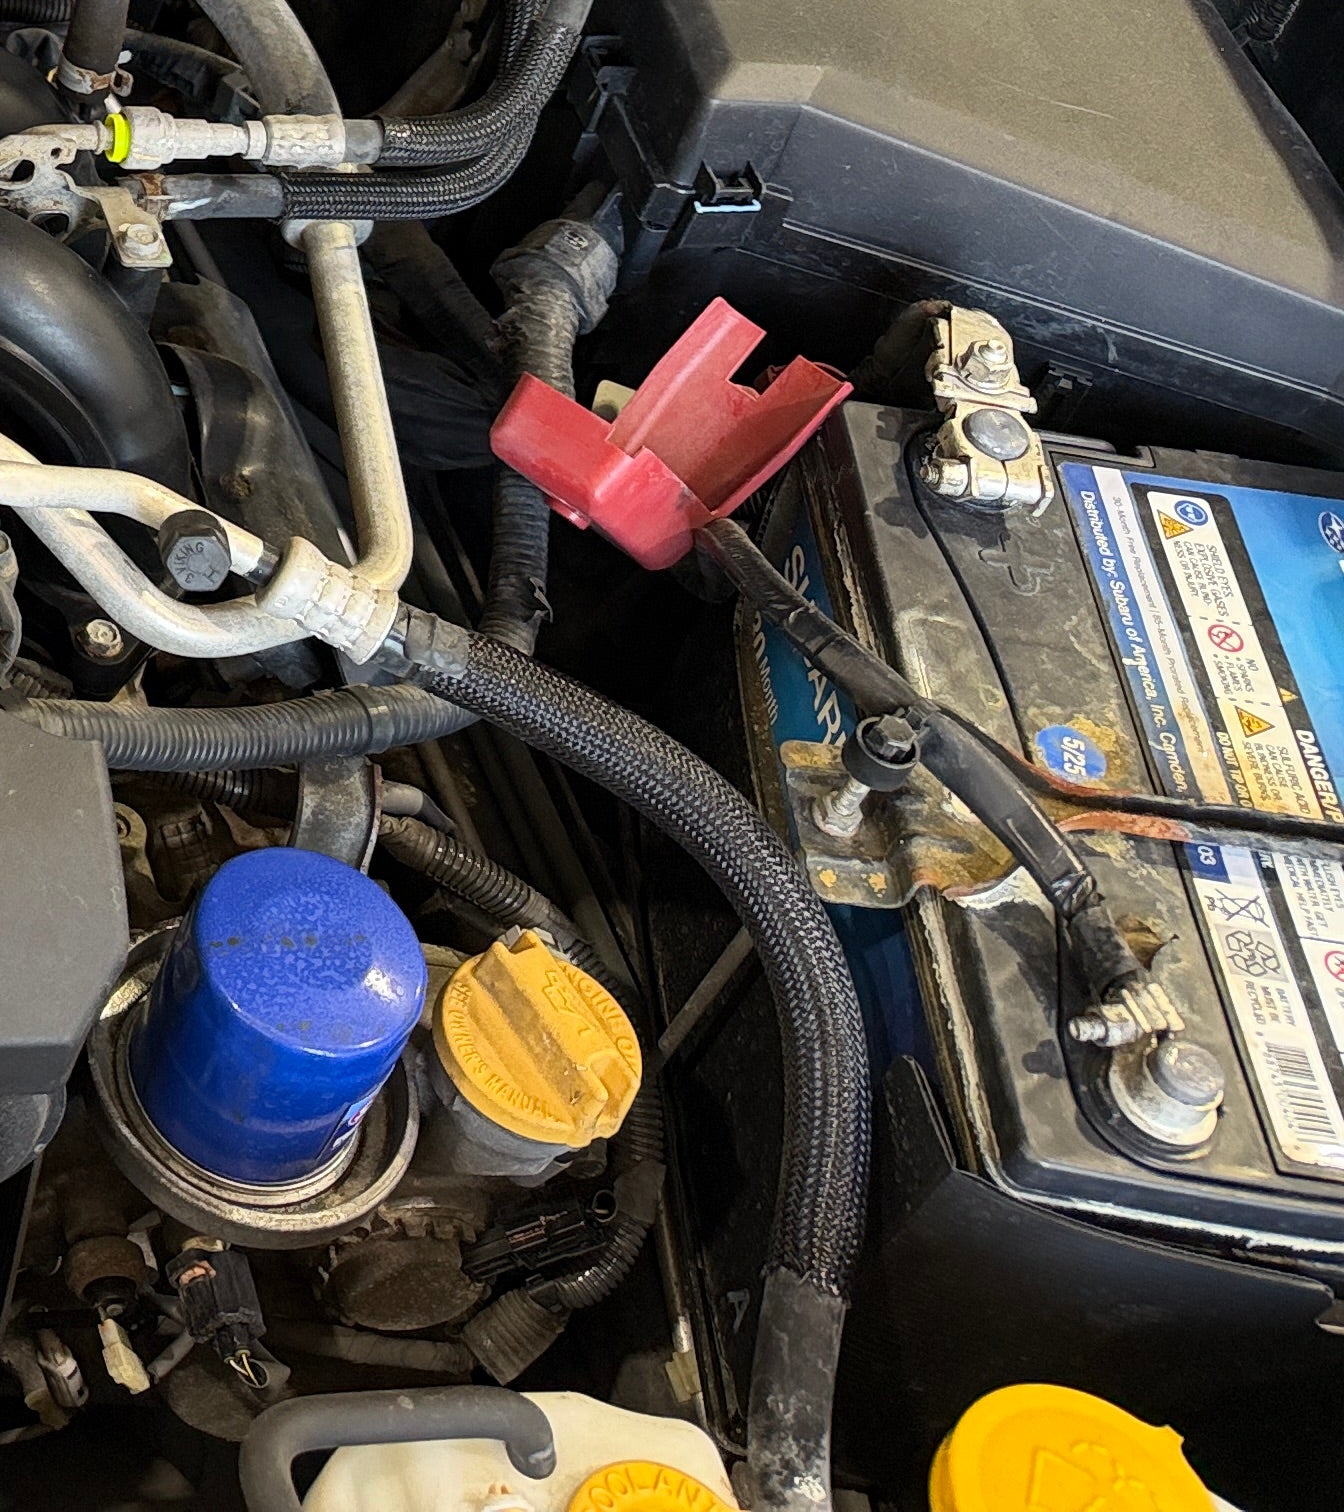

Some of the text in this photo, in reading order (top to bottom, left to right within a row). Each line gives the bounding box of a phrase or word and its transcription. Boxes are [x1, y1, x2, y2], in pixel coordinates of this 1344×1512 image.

[1078, 490, 1116, 556] Distributed
[174, 541, 204, 576] VIKING
[1098, 557, 1122, 578] by:
[1107, 579, 1137, 625] Subaru
[1123, 627, 1143, 642] of
[1148, 704, 1171, 728] Inc.
[1062, 736, 1086, 776] 5/25
